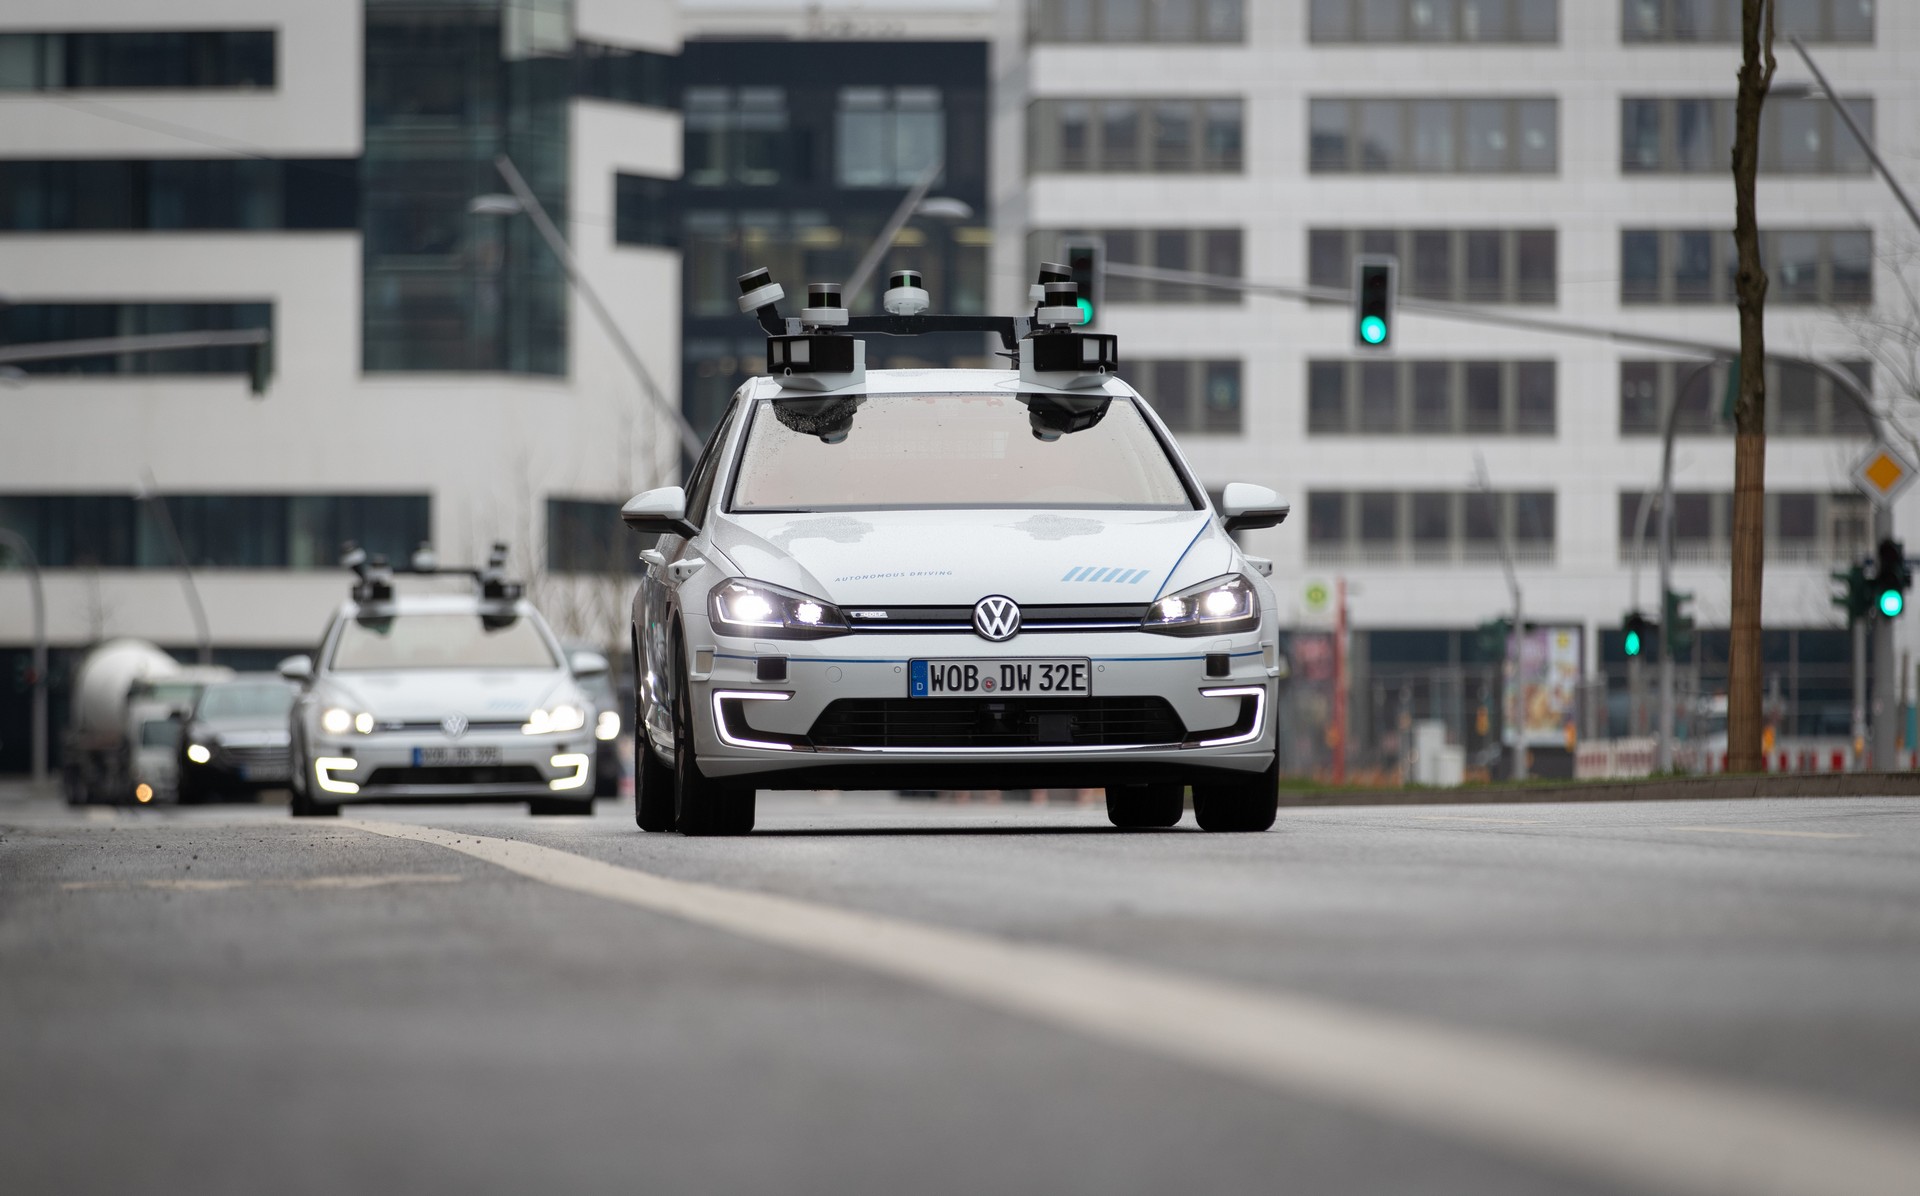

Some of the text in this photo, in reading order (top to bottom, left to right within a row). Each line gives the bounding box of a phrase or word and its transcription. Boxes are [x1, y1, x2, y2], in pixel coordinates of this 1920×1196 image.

[834, 571, 905, 582] AUTONOMOUS
[977, 598, 1017, 640] VW
[916, 682, 924, 691] D
[930, 664, 1087, 692] WOB DW 32E
